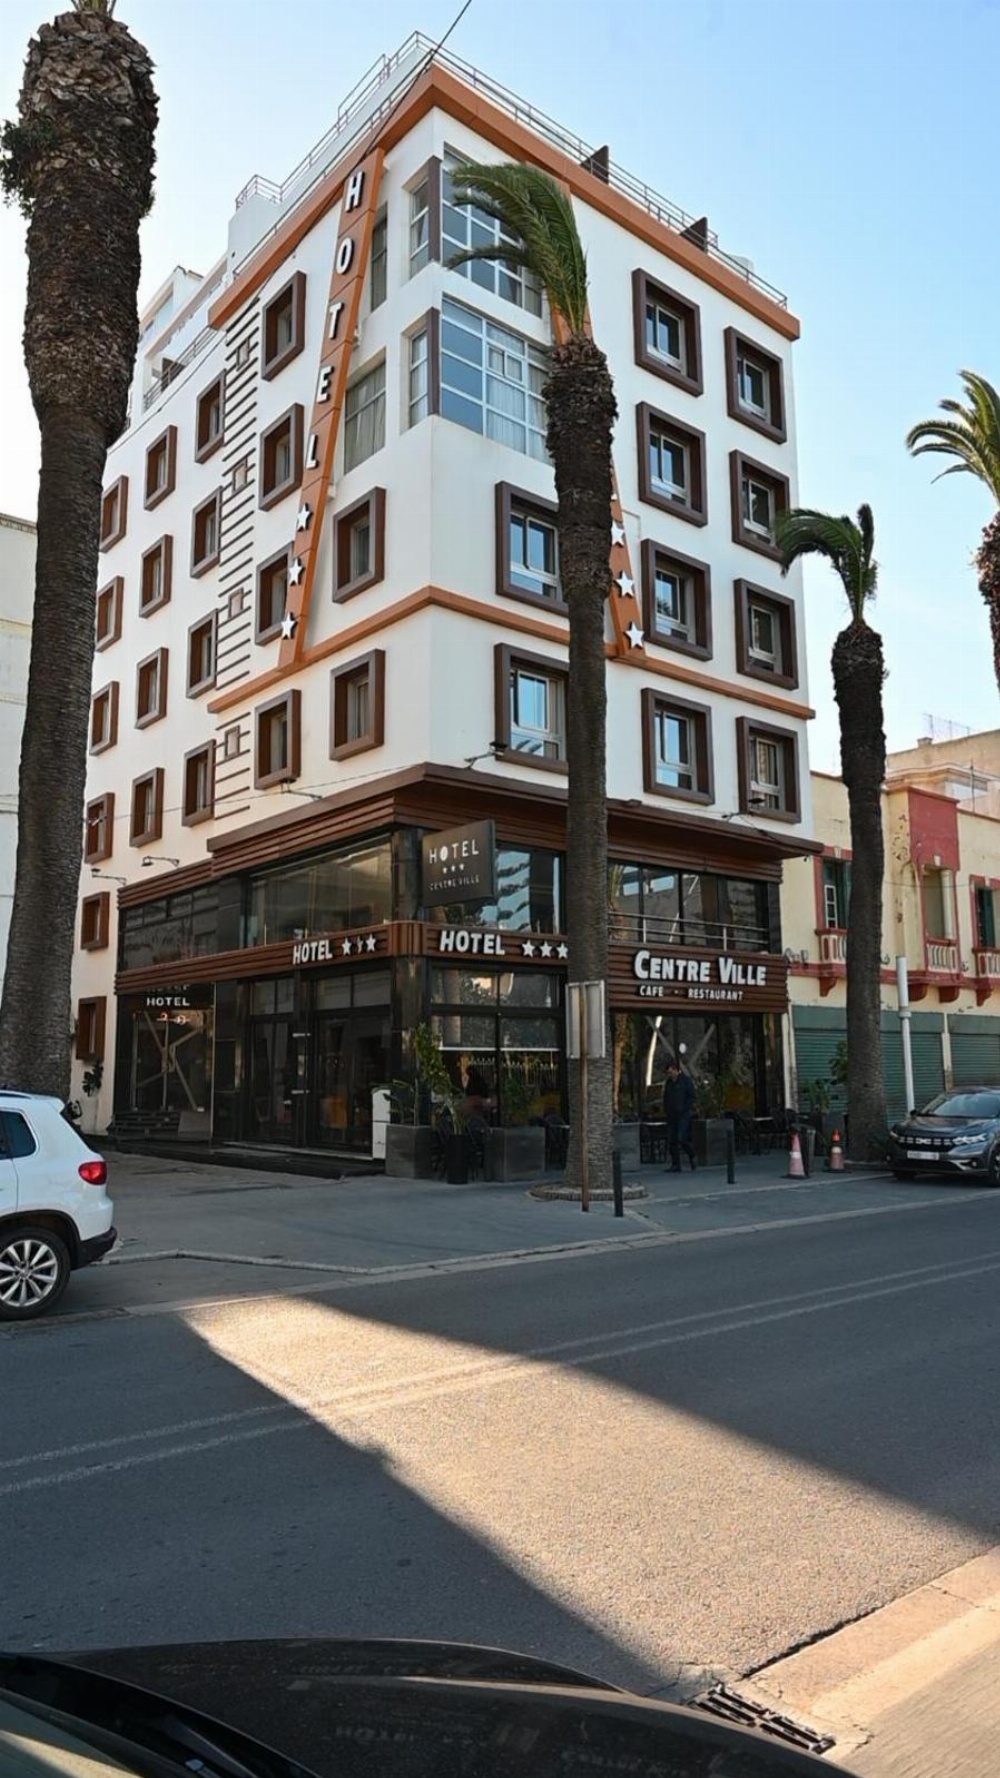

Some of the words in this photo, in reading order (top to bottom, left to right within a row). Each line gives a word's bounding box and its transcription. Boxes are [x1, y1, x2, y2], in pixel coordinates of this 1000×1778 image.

[306, 170, 365, 469] HOTEL
[429, 839, 479, 864] HOTEL
[292, 939, 333, 965] HOTEL
[440, 930, 506, 955] HOTEL
[634, 950, 711, 982] CENTRE
[718, 957, 767, 986] VILLE
[146, 997, 190, 1007] HOTEL
[639, 985, 664, 997] CAFE
[688, 988, 743, 1001] RESTAURANT
